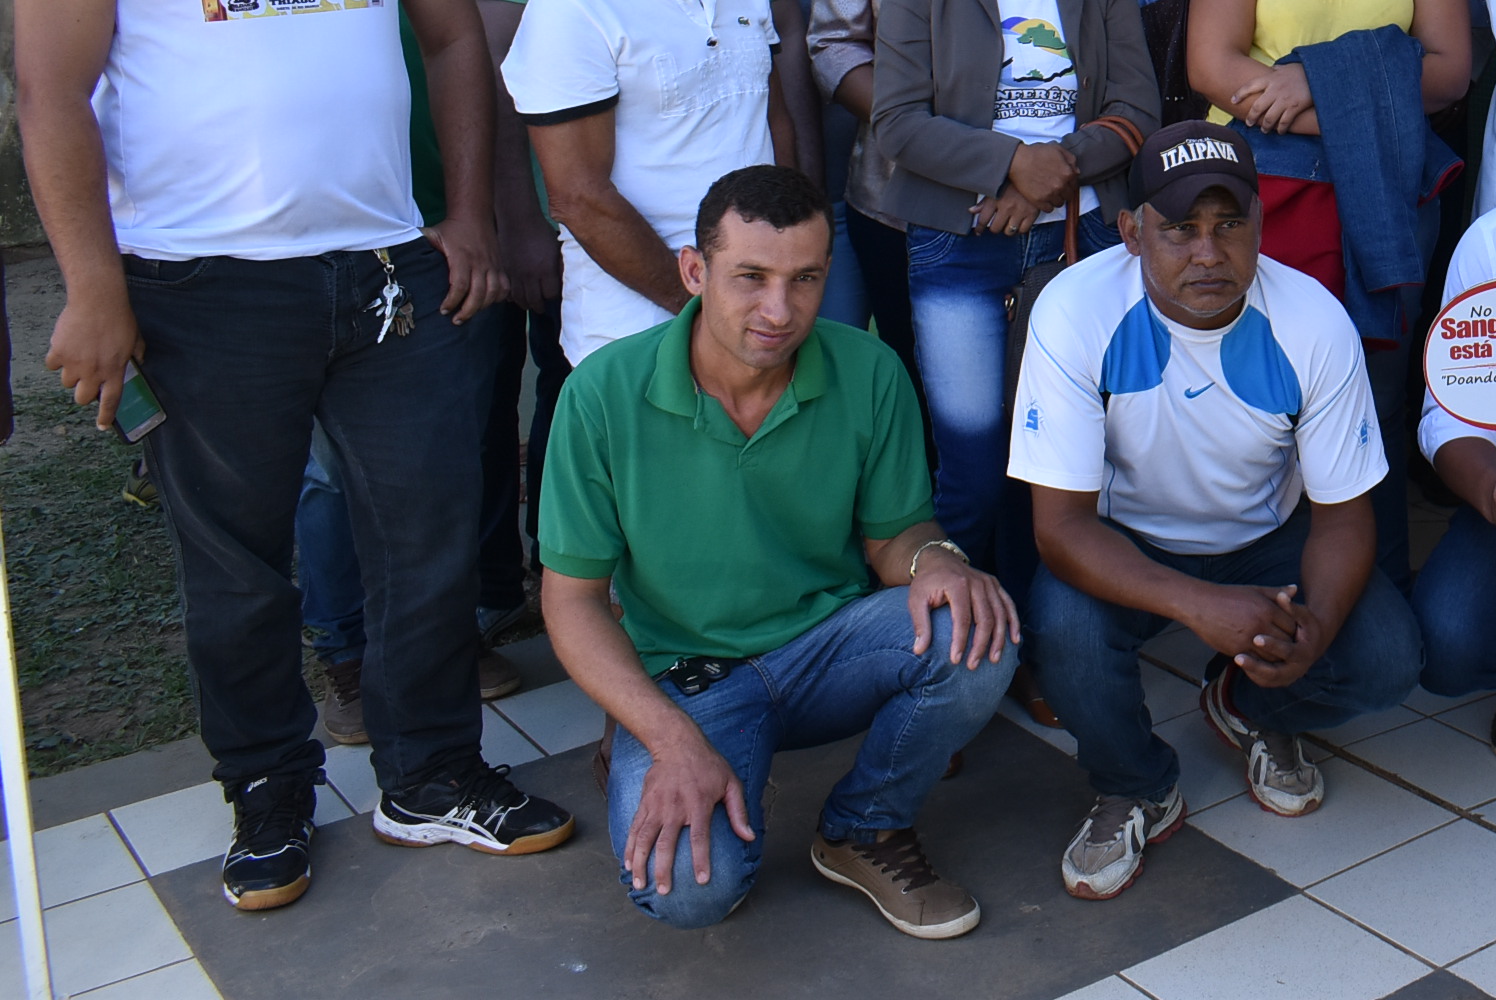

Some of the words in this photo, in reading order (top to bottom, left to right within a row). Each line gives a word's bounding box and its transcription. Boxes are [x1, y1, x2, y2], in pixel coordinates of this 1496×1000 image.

[1161, 141, 1239, 172] ITAIPAVA
[1470, 305, 1492, 318] No
[1449, 339, 1493, 360] está
